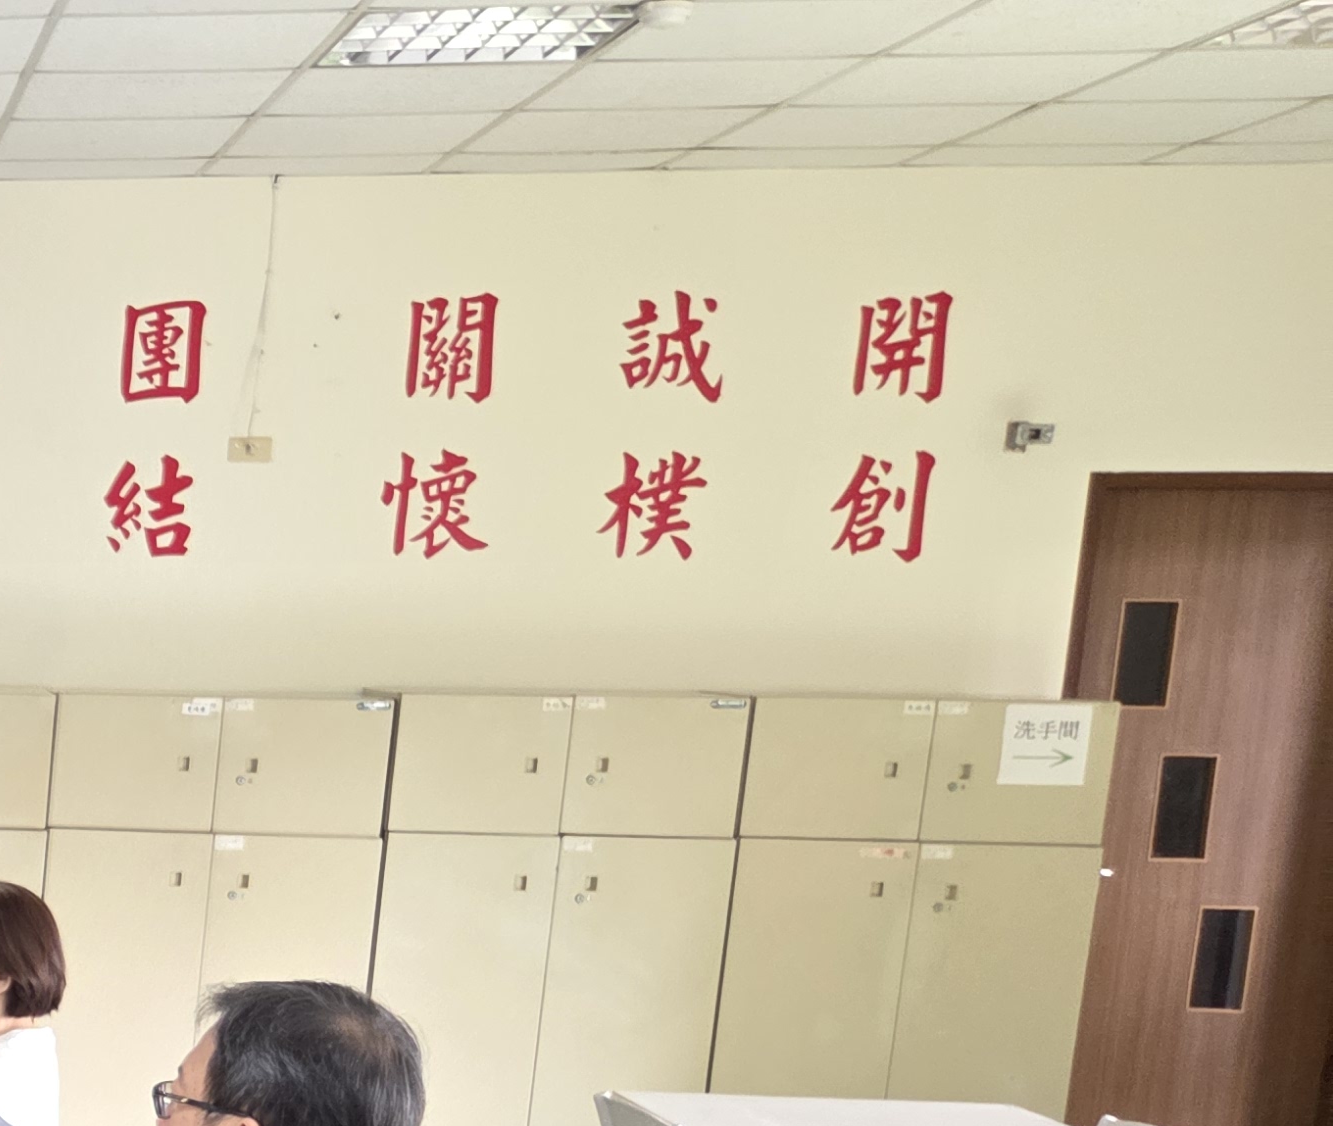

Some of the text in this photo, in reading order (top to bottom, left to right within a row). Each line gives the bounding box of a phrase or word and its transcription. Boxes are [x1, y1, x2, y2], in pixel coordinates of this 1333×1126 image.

[104, 300, 208, 558] 團結
[382, 292, 499, 559] 關懷
[598, 291, 723, 560] 誠樸
[831, 291, 953, 563] 開創
[1013, 719, 1080, 740] 洗手間
